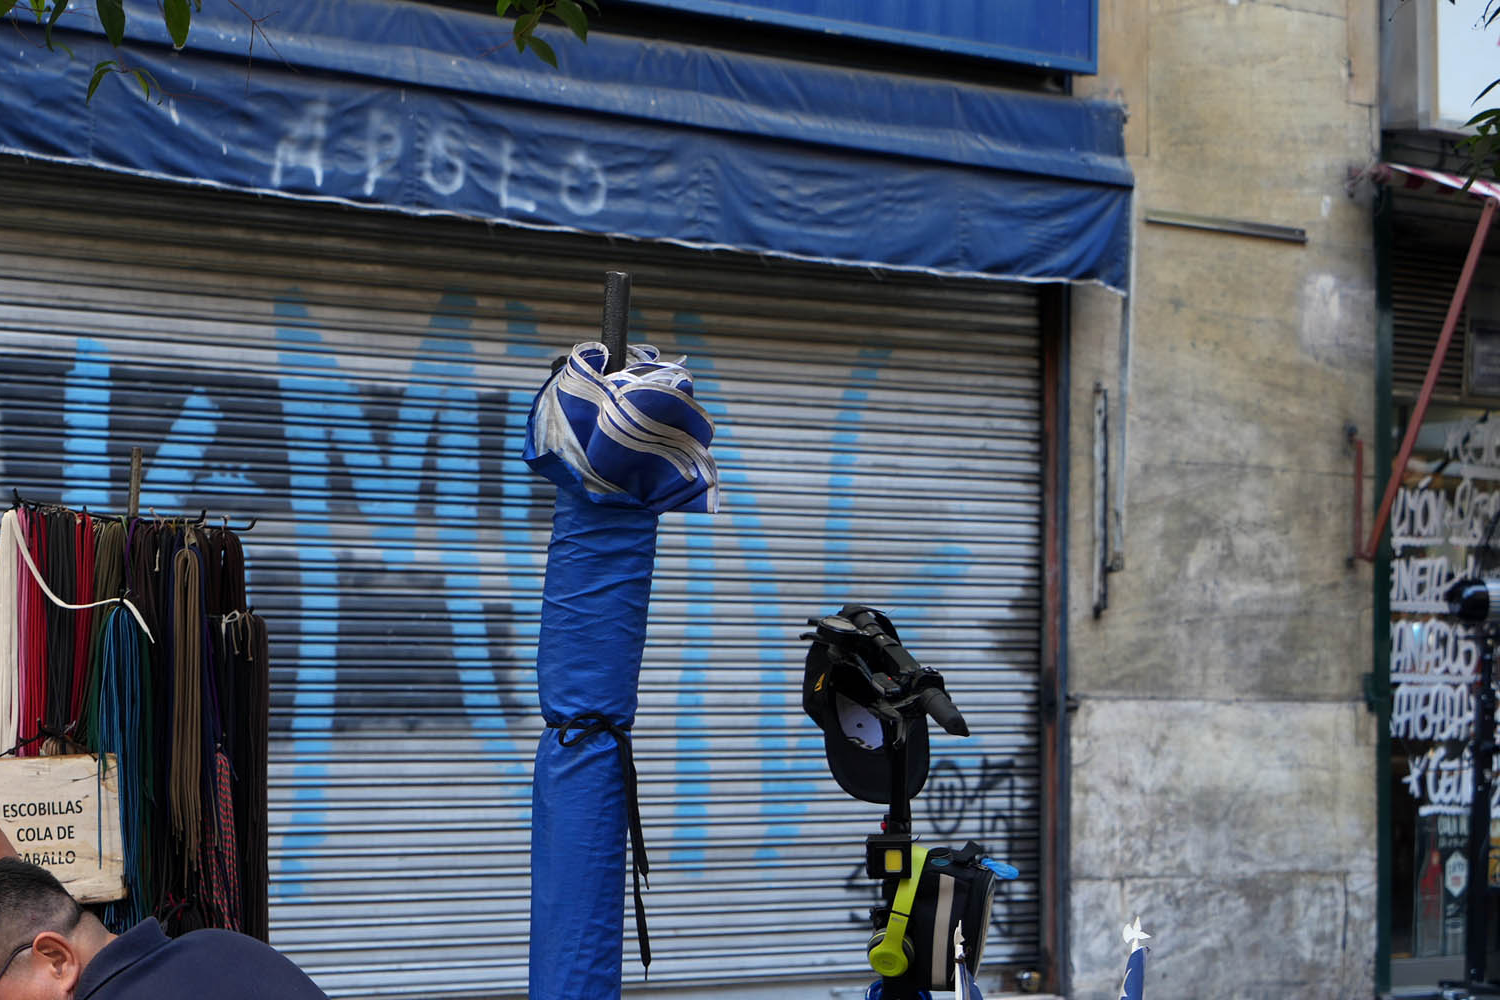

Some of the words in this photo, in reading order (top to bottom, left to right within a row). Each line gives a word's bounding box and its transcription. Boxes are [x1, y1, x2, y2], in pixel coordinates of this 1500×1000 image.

[3, 800, 83, 818] ESCOBILLAS
[16, 827, 53, 842] COLA
[57, 825, 75, 840] DE
[17, 850, 77, 866] ABALLO
